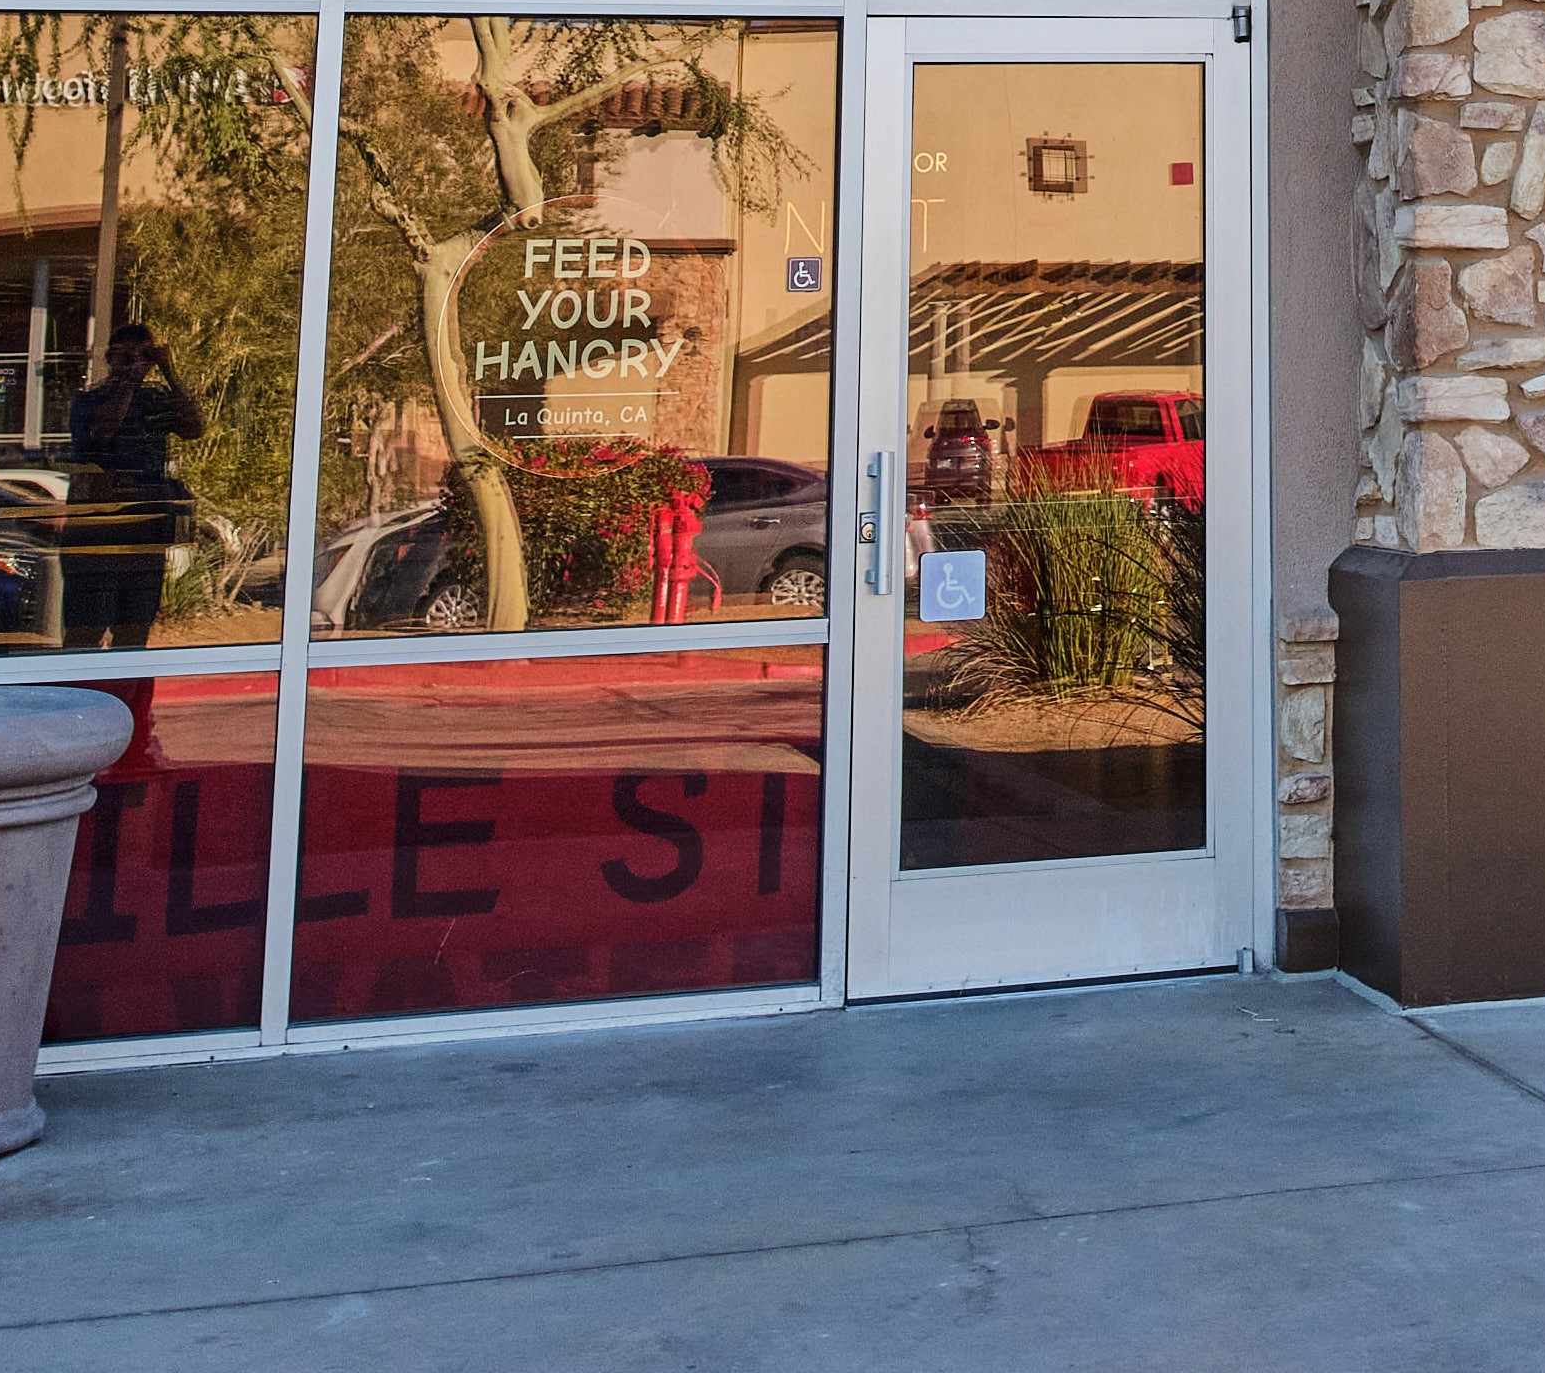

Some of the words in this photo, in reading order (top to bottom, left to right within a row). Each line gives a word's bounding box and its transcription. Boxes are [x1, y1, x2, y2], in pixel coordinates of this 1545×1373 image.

[524, 238, 652, 279] FEED
[516, 288, 652, 330] YOUR
[475, 337, 686, 381] HANGRY
[505, 408, 528, 426] La
[536, 407, 611, 427] Quinta,
[620, 405, 648, 424] CA
